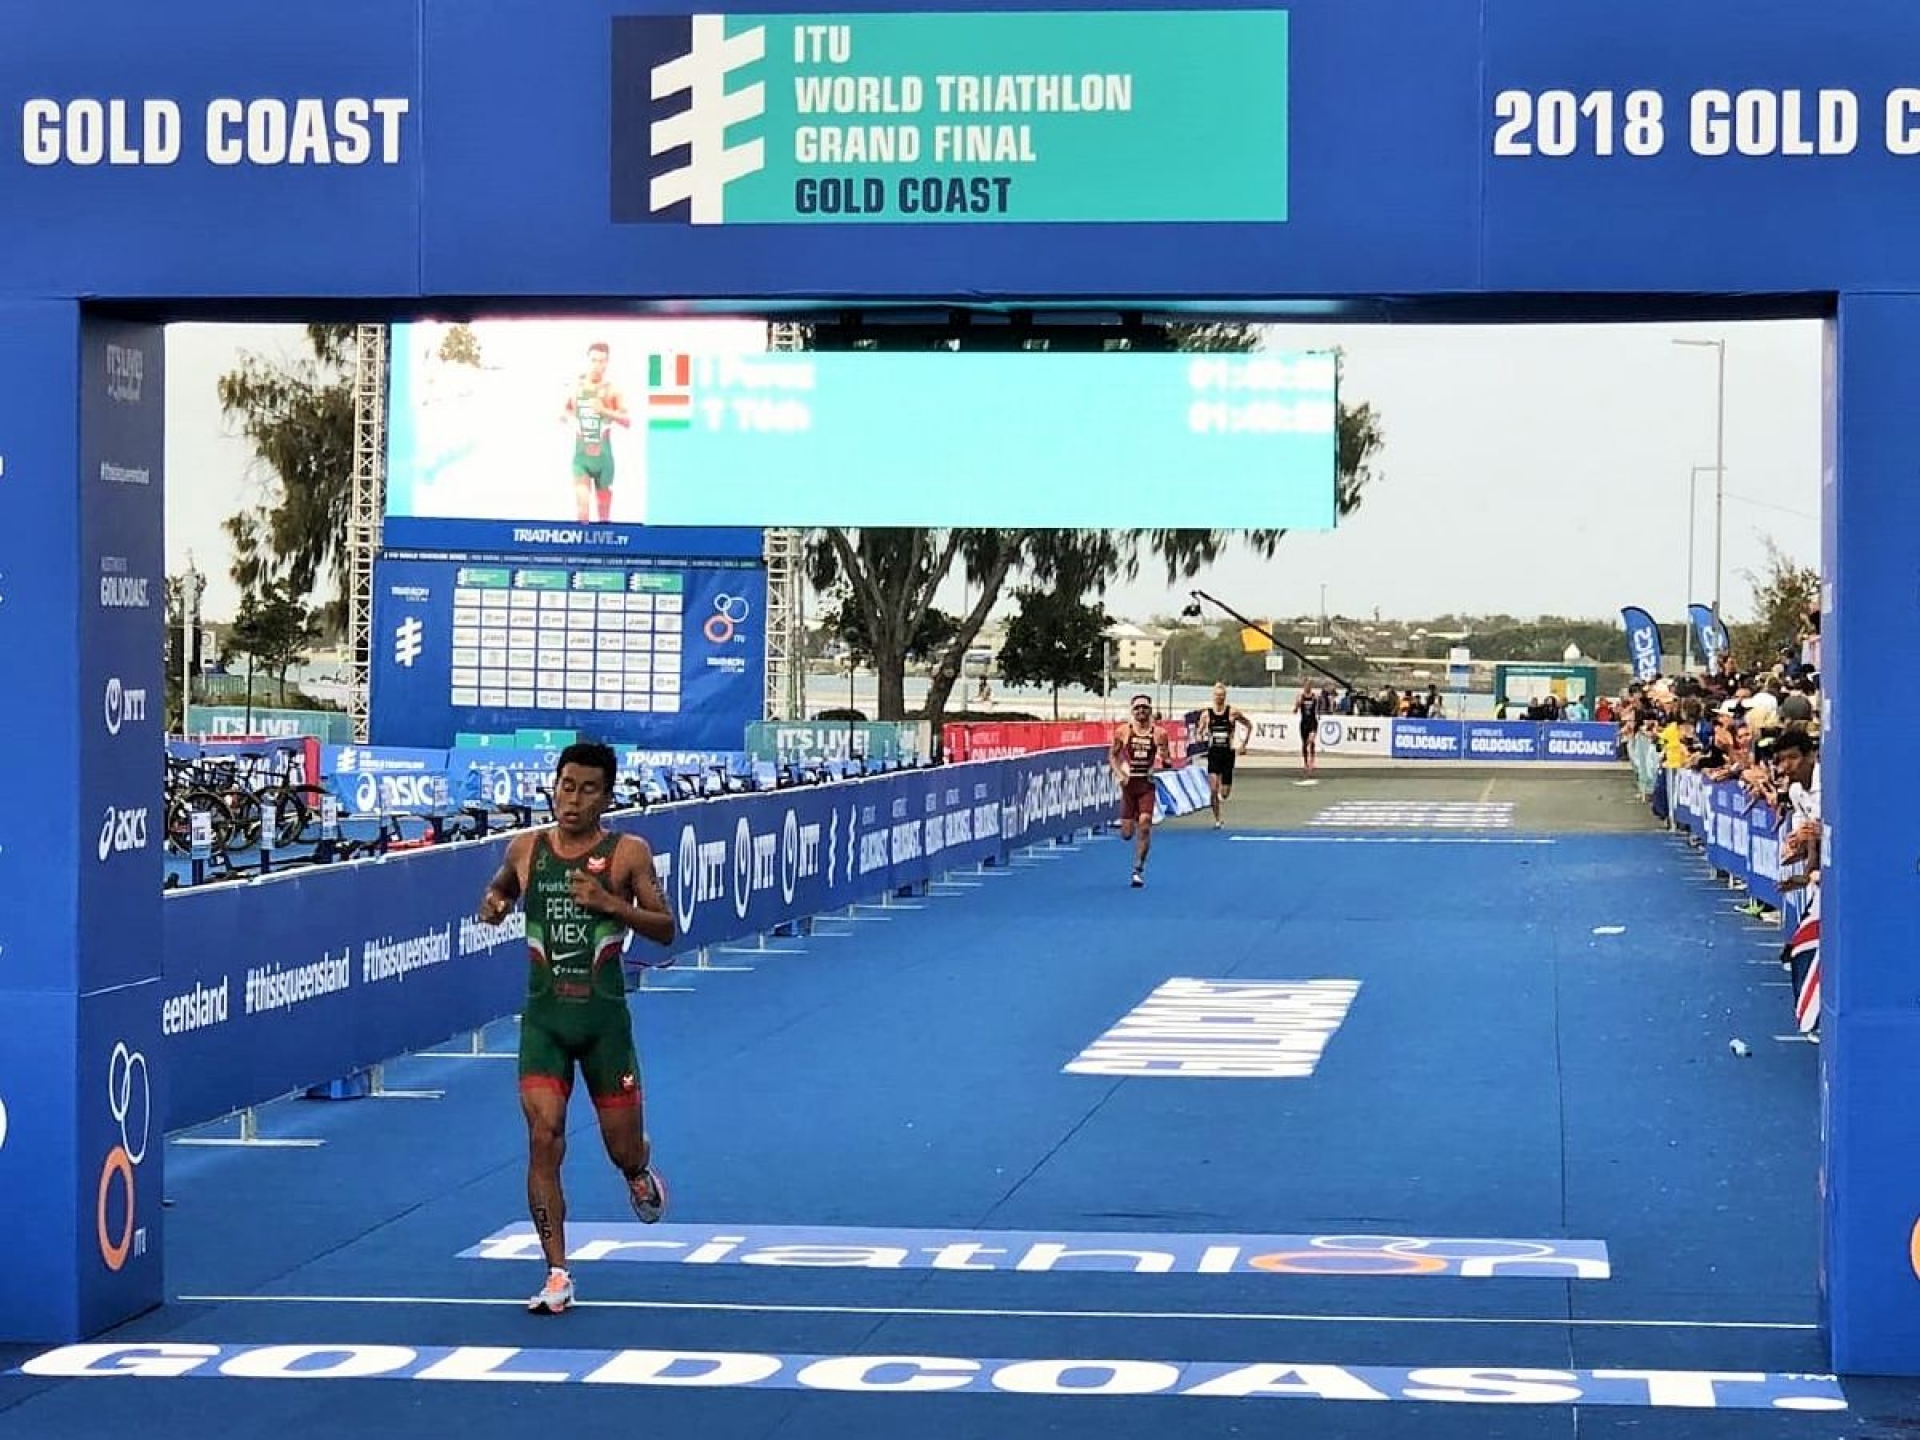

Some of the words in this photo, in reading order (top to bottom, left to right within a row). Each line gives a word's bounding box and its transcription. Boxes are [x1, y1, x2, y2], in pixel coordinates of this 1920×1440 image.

[794, 25, 850, 63] ITU
[794, 77, 922, 114] WORLD
[936, 74, 1132, 112] TRIATHLON
[22, 99, 180, 164] GOLD
[206, 98, 409, 164] COAST
[1493, 90, 1664, 156] 2018
[1690, 89, 1858, 155] GOLD
[794, 127, 919, 163] GRAND
[934, 125, 1036, 162] FINAL
[794, 178, 884, 214] GOLD
[899, 176, 1011, 213] COAST
[512, 528, 582, 544] TRIATHLON
[124, 689, 146, 721] NTT
[777, 729, 814, 750] IT'S
[1255, 722, 1288, 739] NTT
[1347, 727, 1380, 743] NTT
[753, 833, 777, 891] NTT
[799, 824, 820, 877] NTT
[698, 841, 726, 902] NTT
[551, 923, 588, 945] MEX
[246, 948, 350, 1014] #thisisqueensland
[478, 1222, 1609, 1278] triathlon
